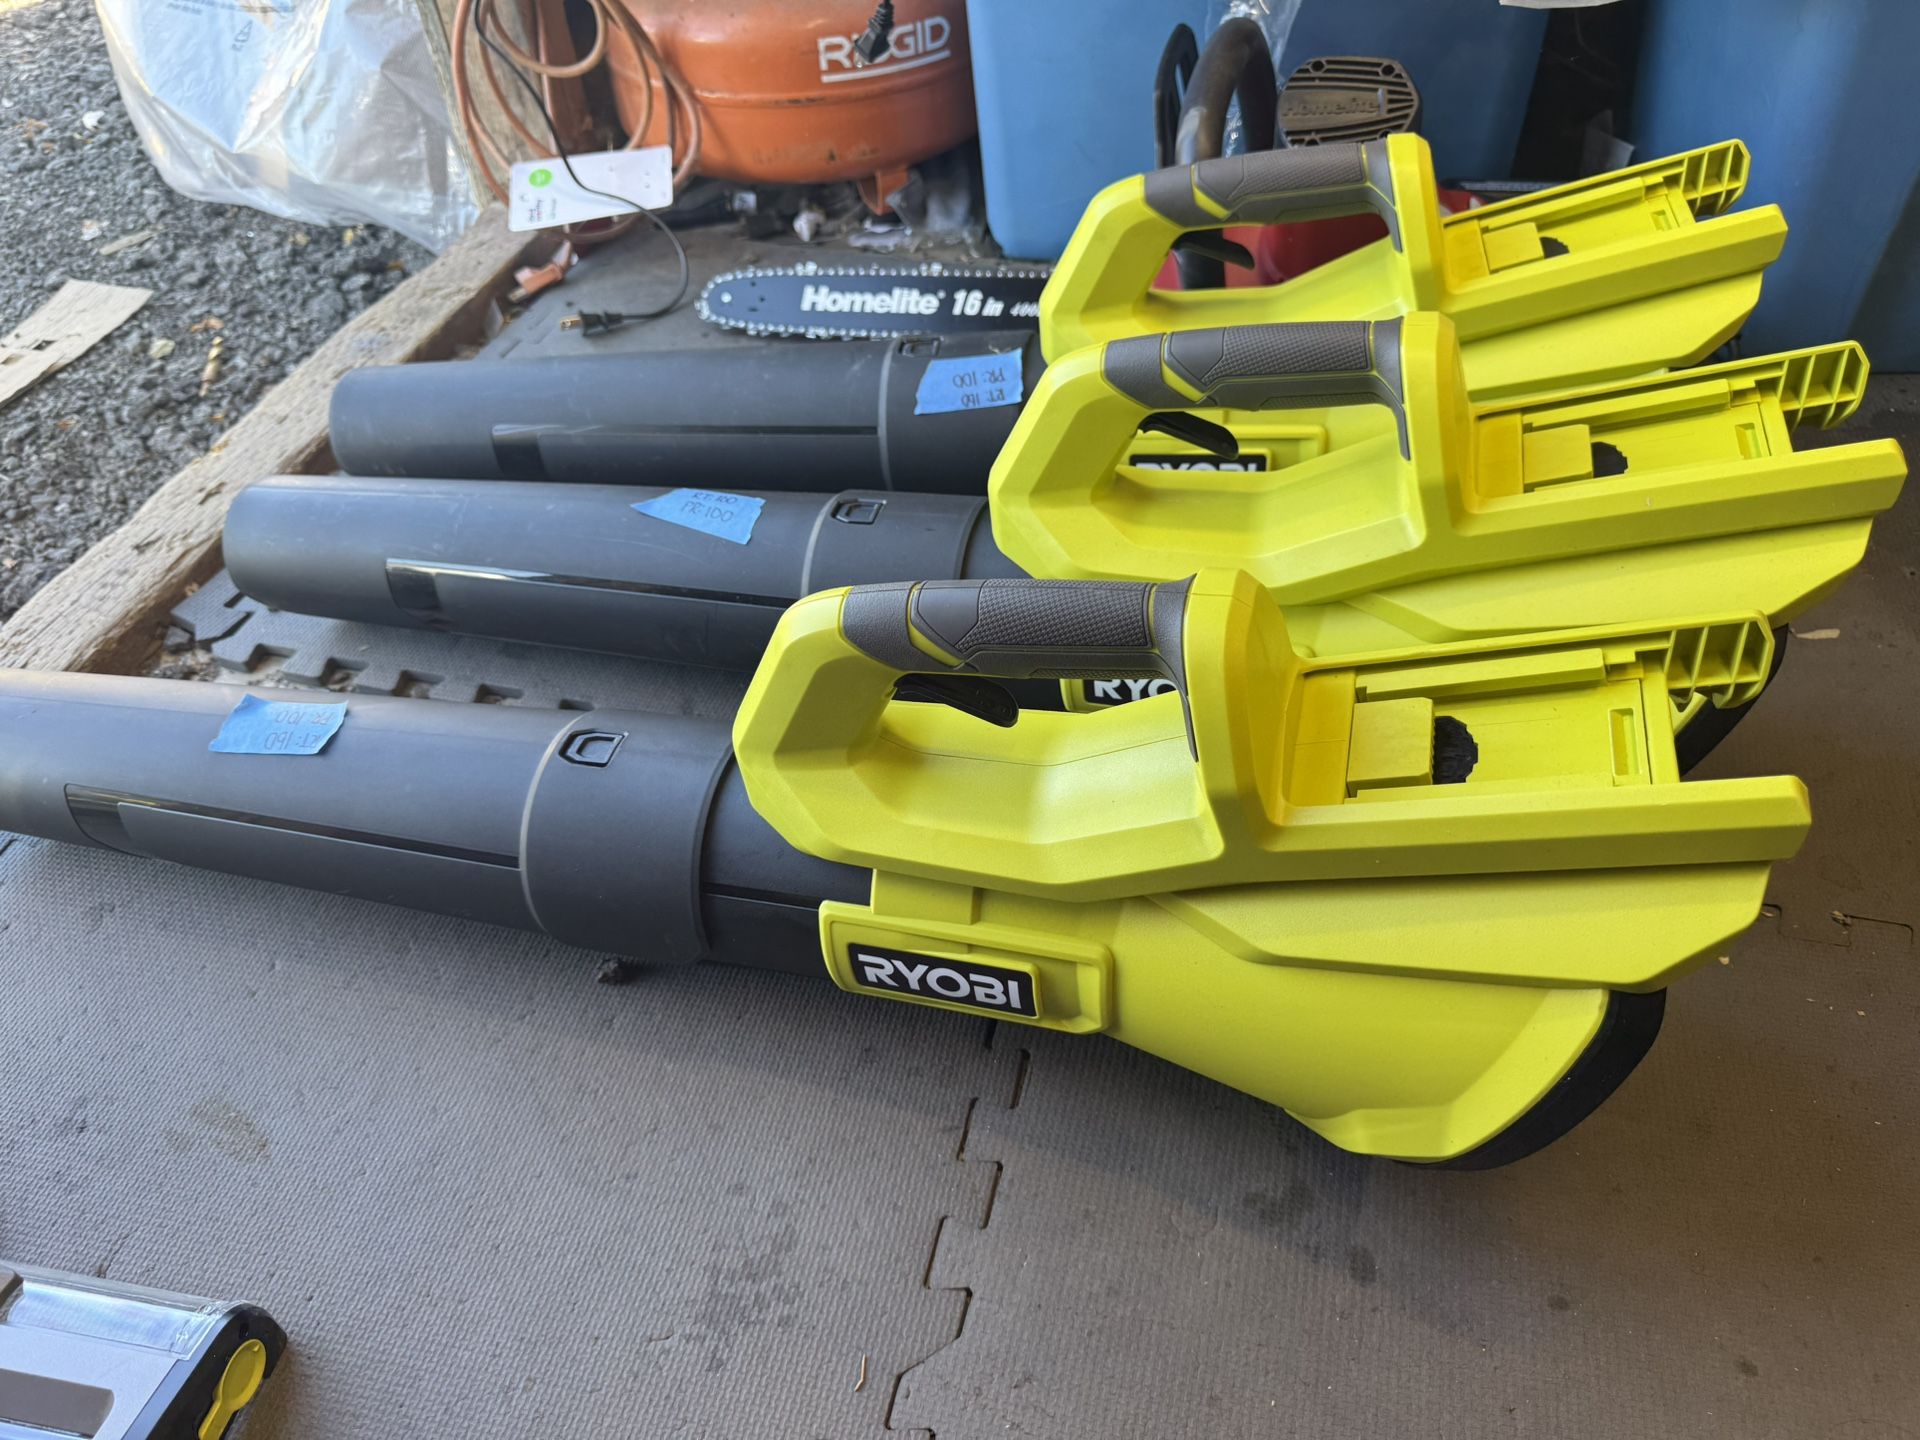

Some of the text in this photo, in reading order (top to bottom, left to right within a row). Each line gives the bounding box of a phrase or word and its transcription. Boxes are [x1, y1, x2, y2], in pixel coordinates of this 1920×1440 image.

[817, 16, 951, 71] RGID
[952, 289, 983, 316] 16
[981, 298, 1005, 317] in
[952, 371, 977, 388] 100
[705, 506, 734, 522] 100
[1094, 679, 1178, 700] RYO
[857, 953, 1022, 1009] RYOBI
